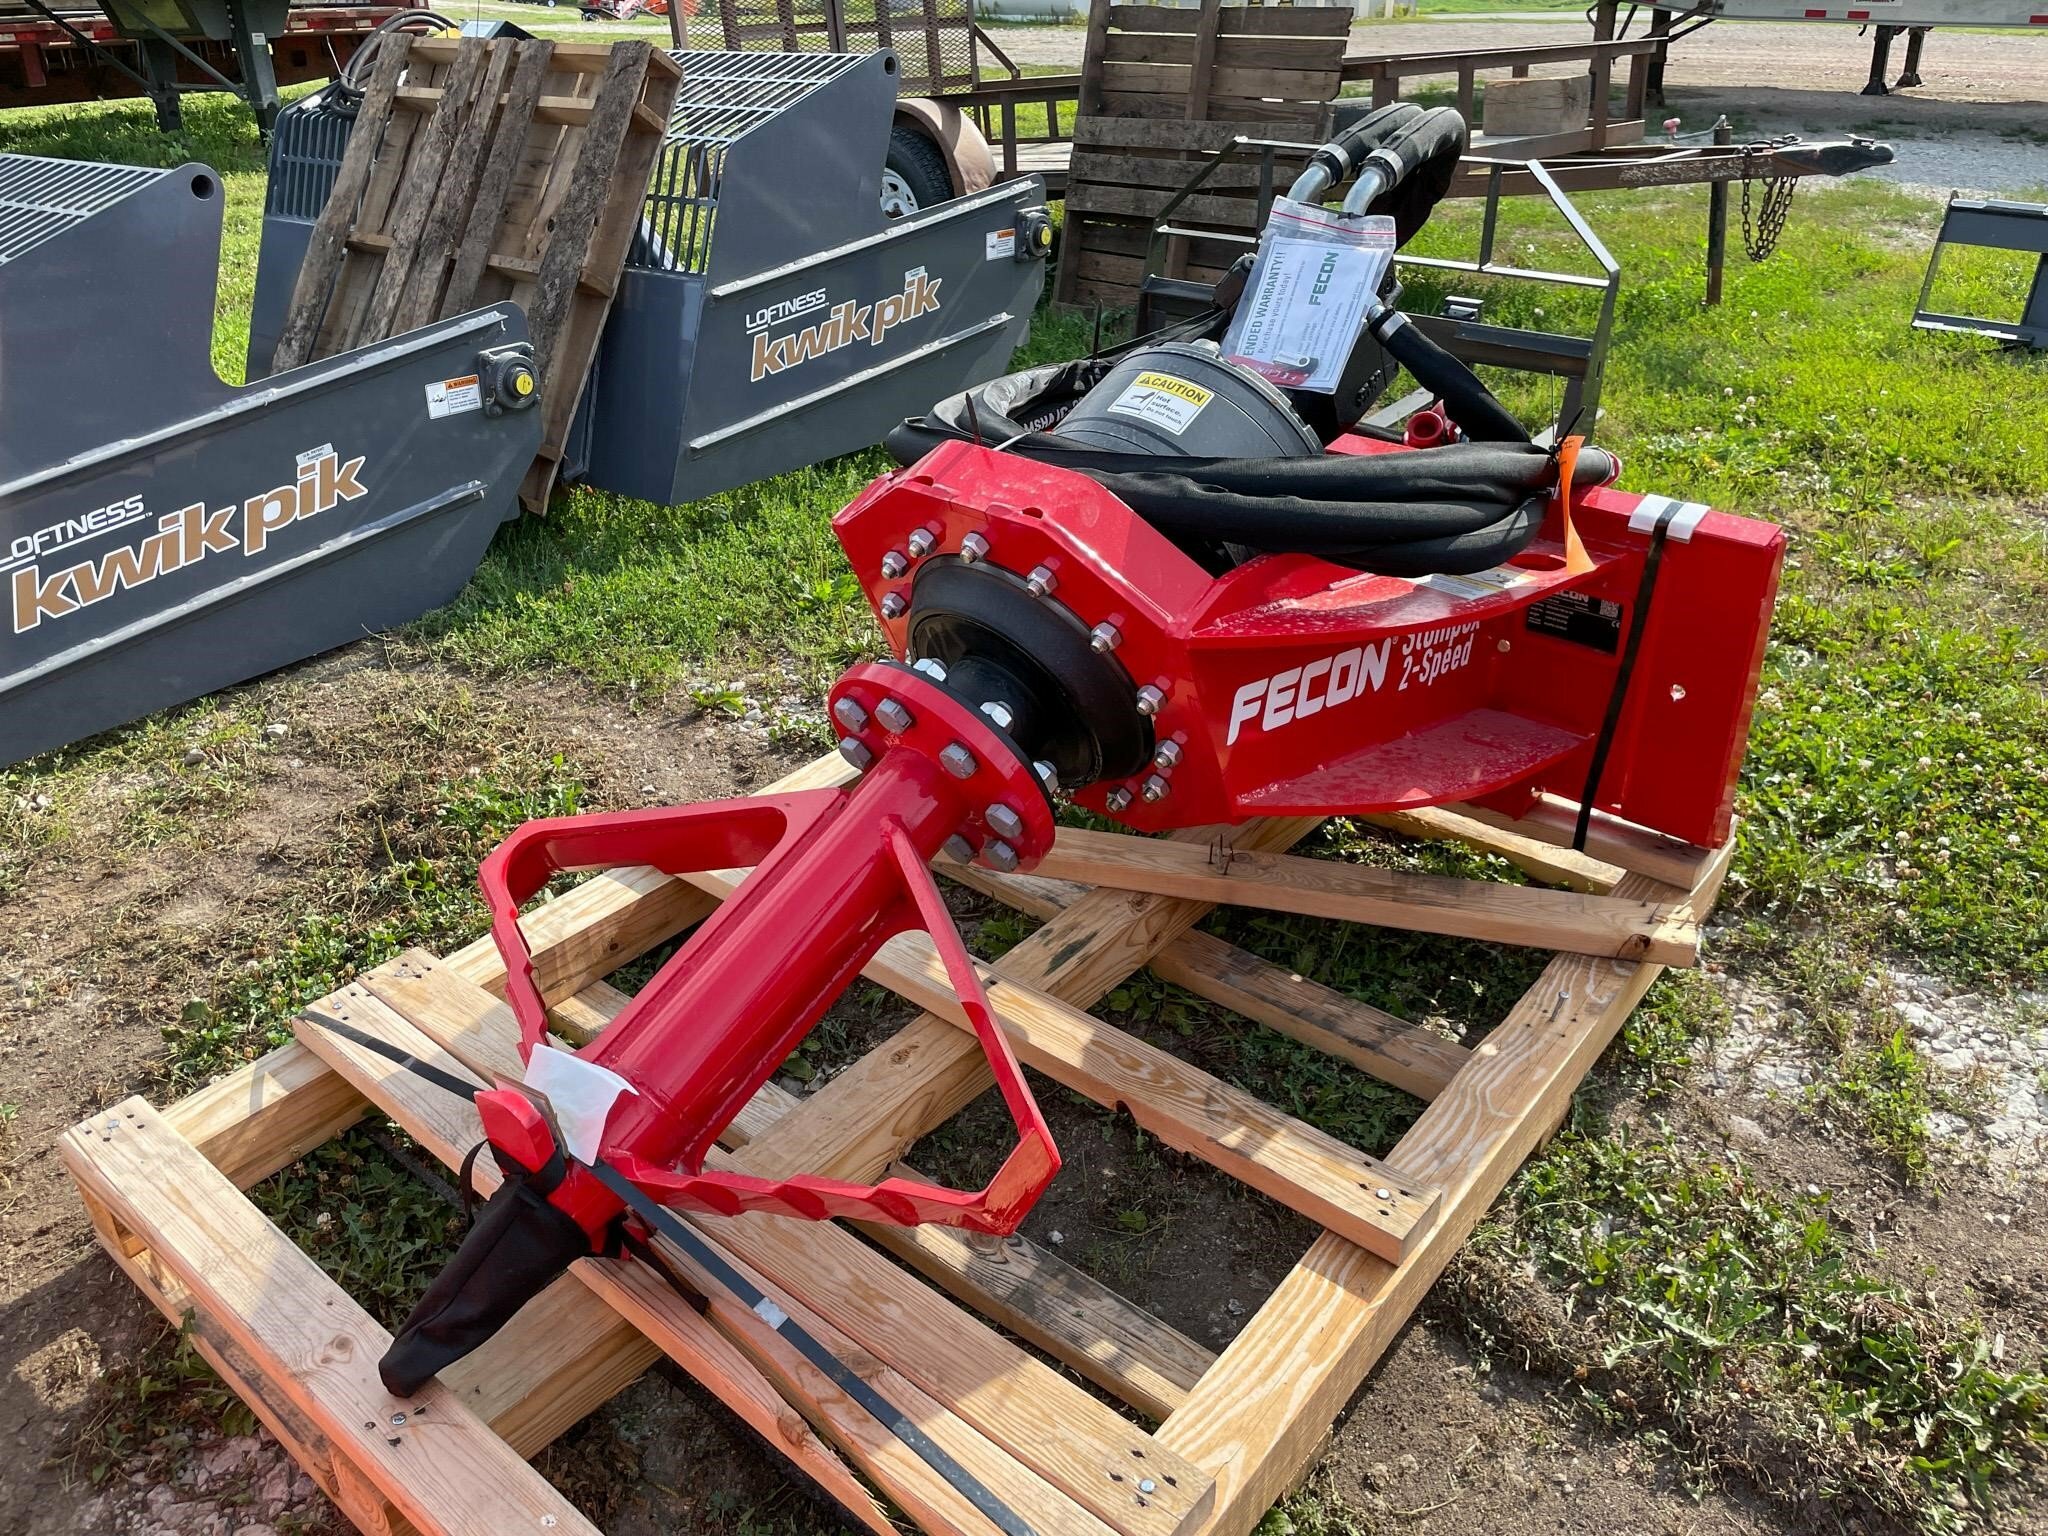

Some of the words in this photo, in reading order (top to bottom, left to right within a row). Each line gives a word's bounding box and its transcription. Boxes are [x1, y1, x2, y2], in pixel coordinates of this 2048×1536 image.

[1308, 252, 1339, 305] FECON
[746, 288, 826, 328] LOFTNESS
[751, 300, 871, 382] kwik
[871, 272, 943, 346] pik
[1243, 321, 1262, 356] ENDED
[1151, 377, 1205, 403] CAUTION
[1155, 395, 1170, 403] Hot
[1024, 412, 1055, 432] MSHA
[12, 502, 240, 633] kwik
[244, 452, 368, 556] pik
[1398, 632, 1474, 691] 2-Speed
[1226, 636, 1392, 746] FECON
